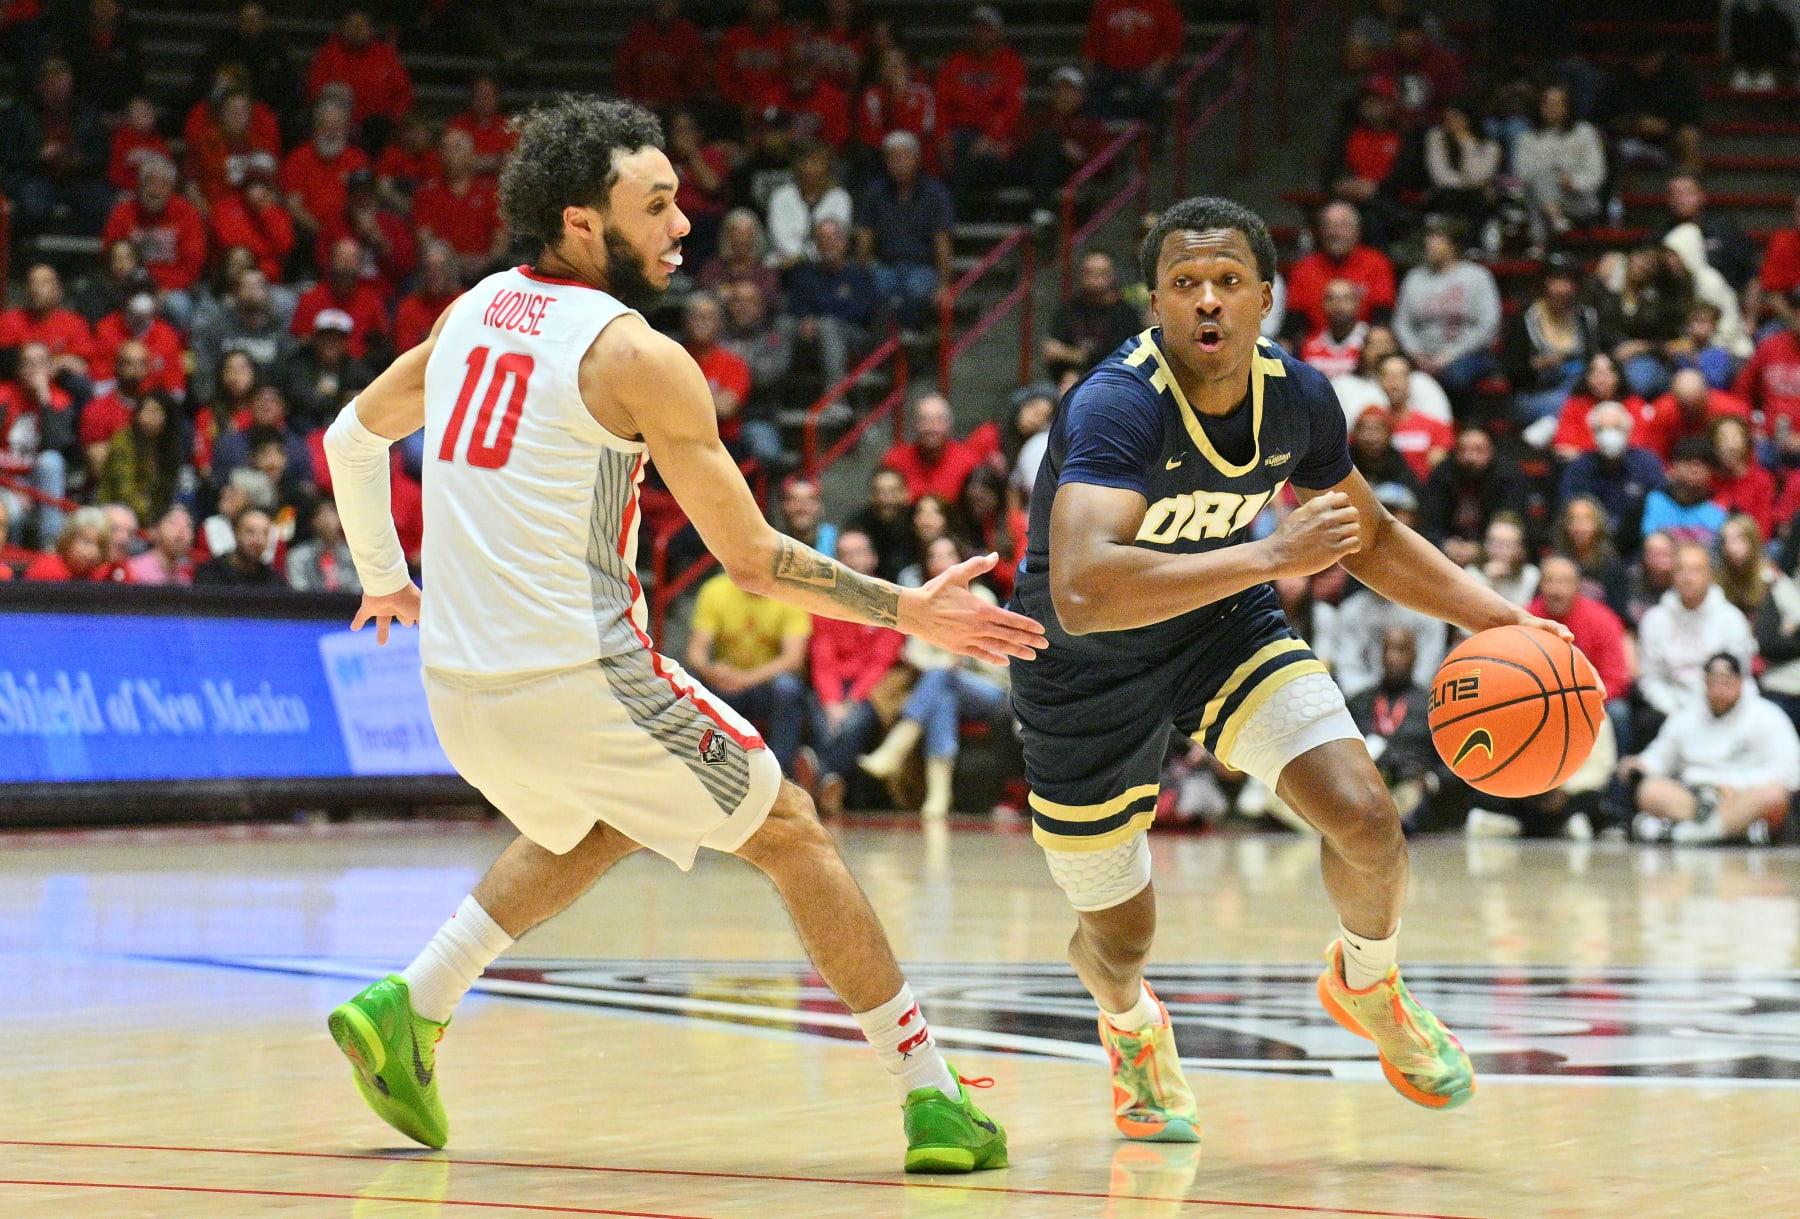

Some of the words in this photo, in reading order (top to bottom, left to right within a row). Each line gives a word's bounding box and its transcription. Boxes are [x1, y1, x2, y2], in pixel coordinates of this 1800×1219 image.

[483, 289, 558, 336] HOUSE
[438, 346, 535, 470] 10
[106, 678, 141, 735] of
[137, 678, 203, 735] New
[202, 679, 311, 735] Mexico
